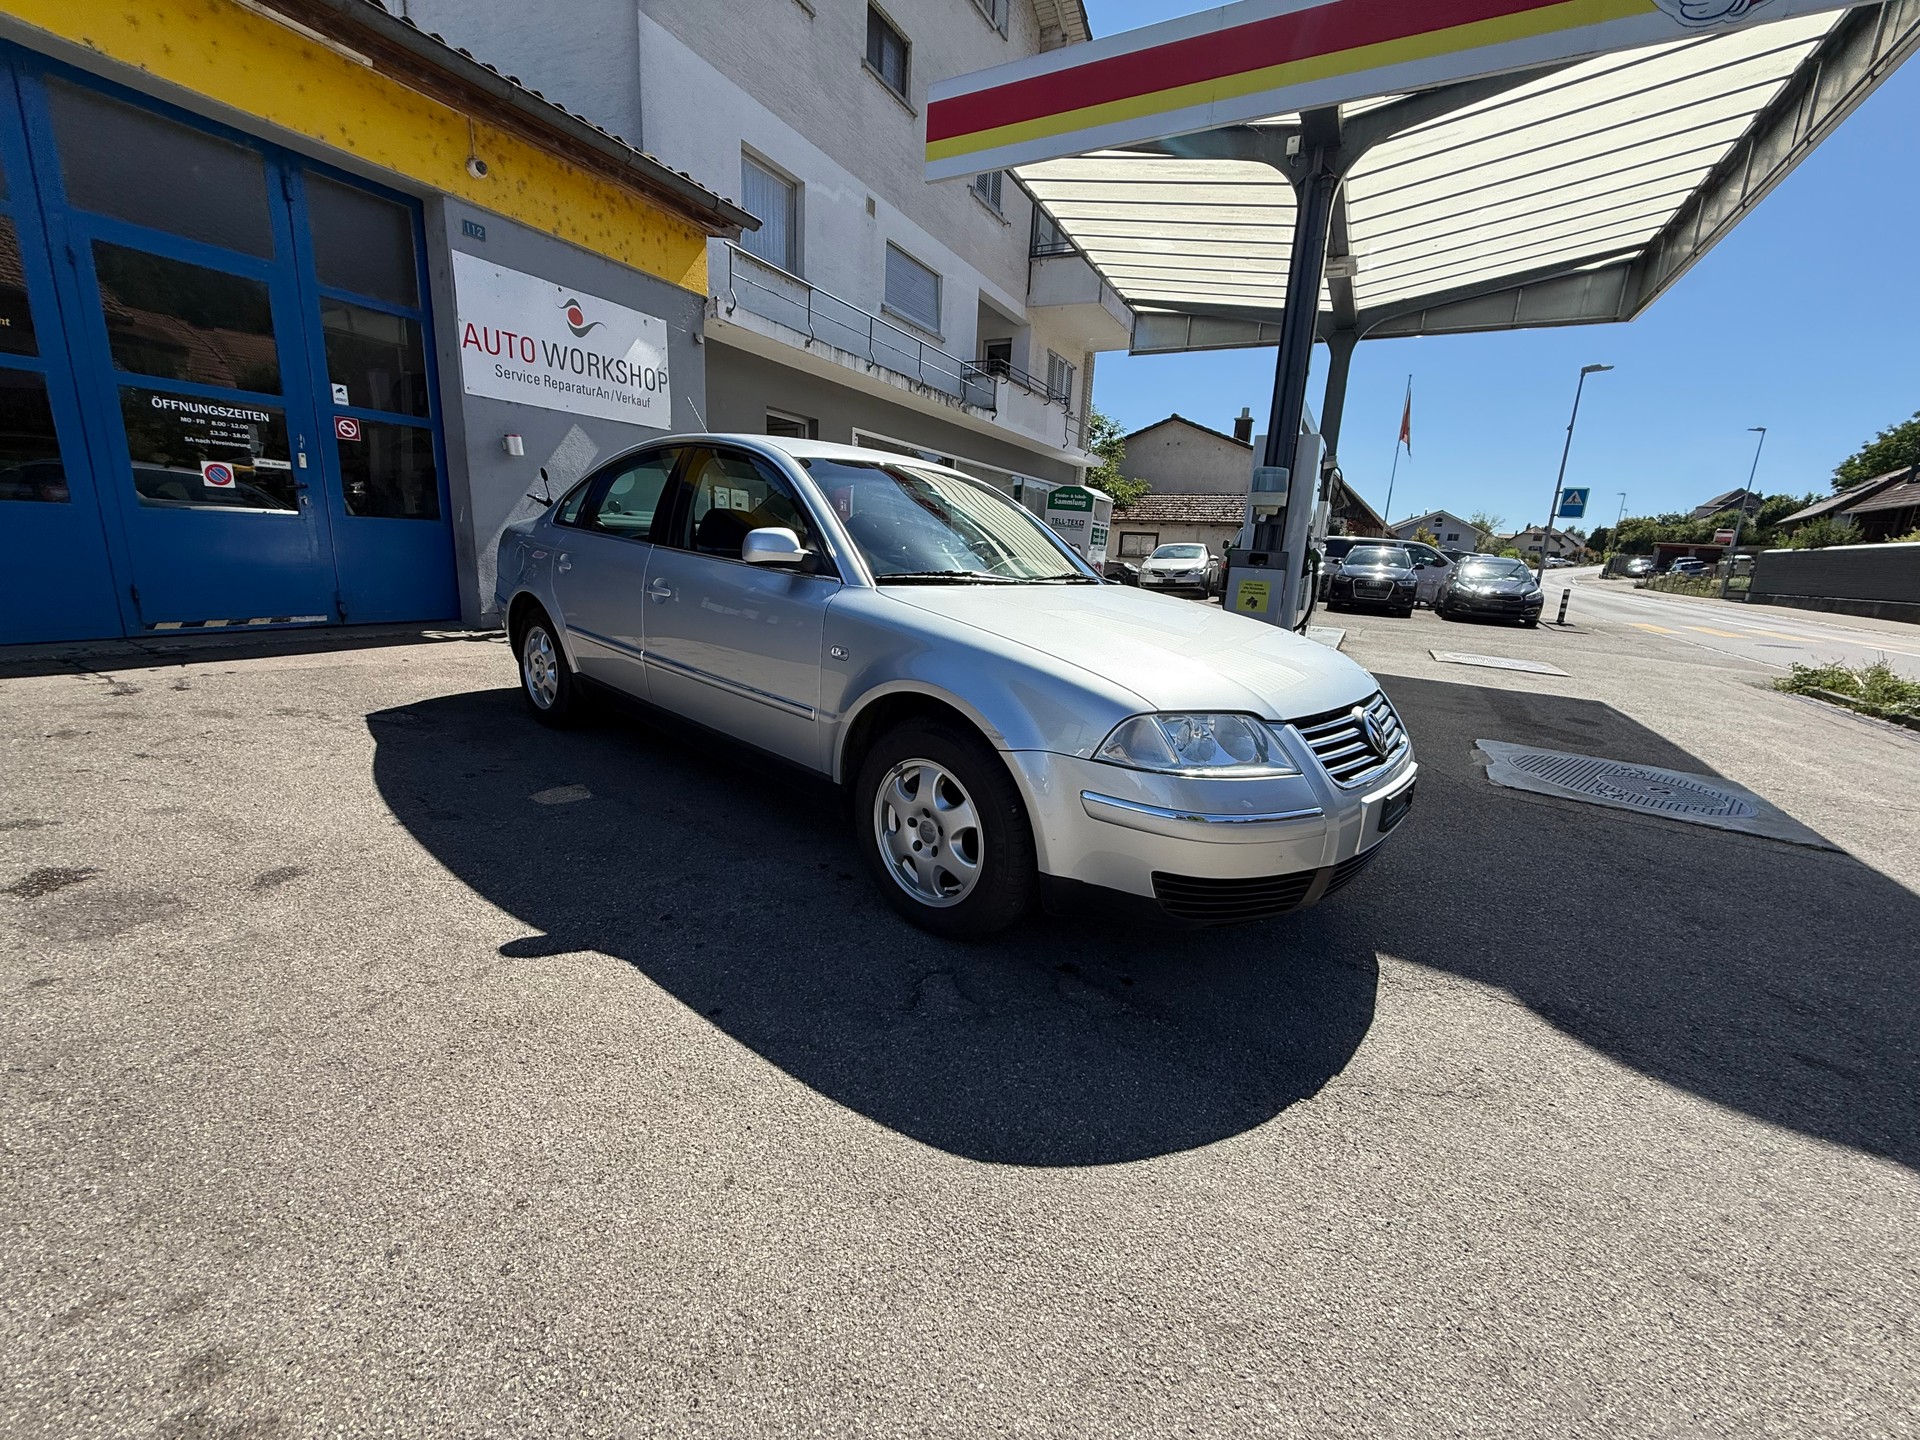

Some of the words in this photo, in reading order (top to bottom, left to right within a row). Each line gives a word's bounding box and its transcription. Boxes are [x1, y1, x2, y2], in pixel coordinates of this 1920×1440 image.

[466, 222, 482, 237] 112
[462, 322, 536, 364] AUTO
[541, 339, 668, 394] WORKSHOP
[494, 364, 541, 386] Service
[151, 395, 270, 422] ÖFFNUNGSZEITEN
[230, 422, 249, 430] 12.00
[210, 439, 252, 449] Vereinbarung
[1054, 498, 1087, 507] Sammlung
[1051, 517, 1079, 525] TELL-TEX
